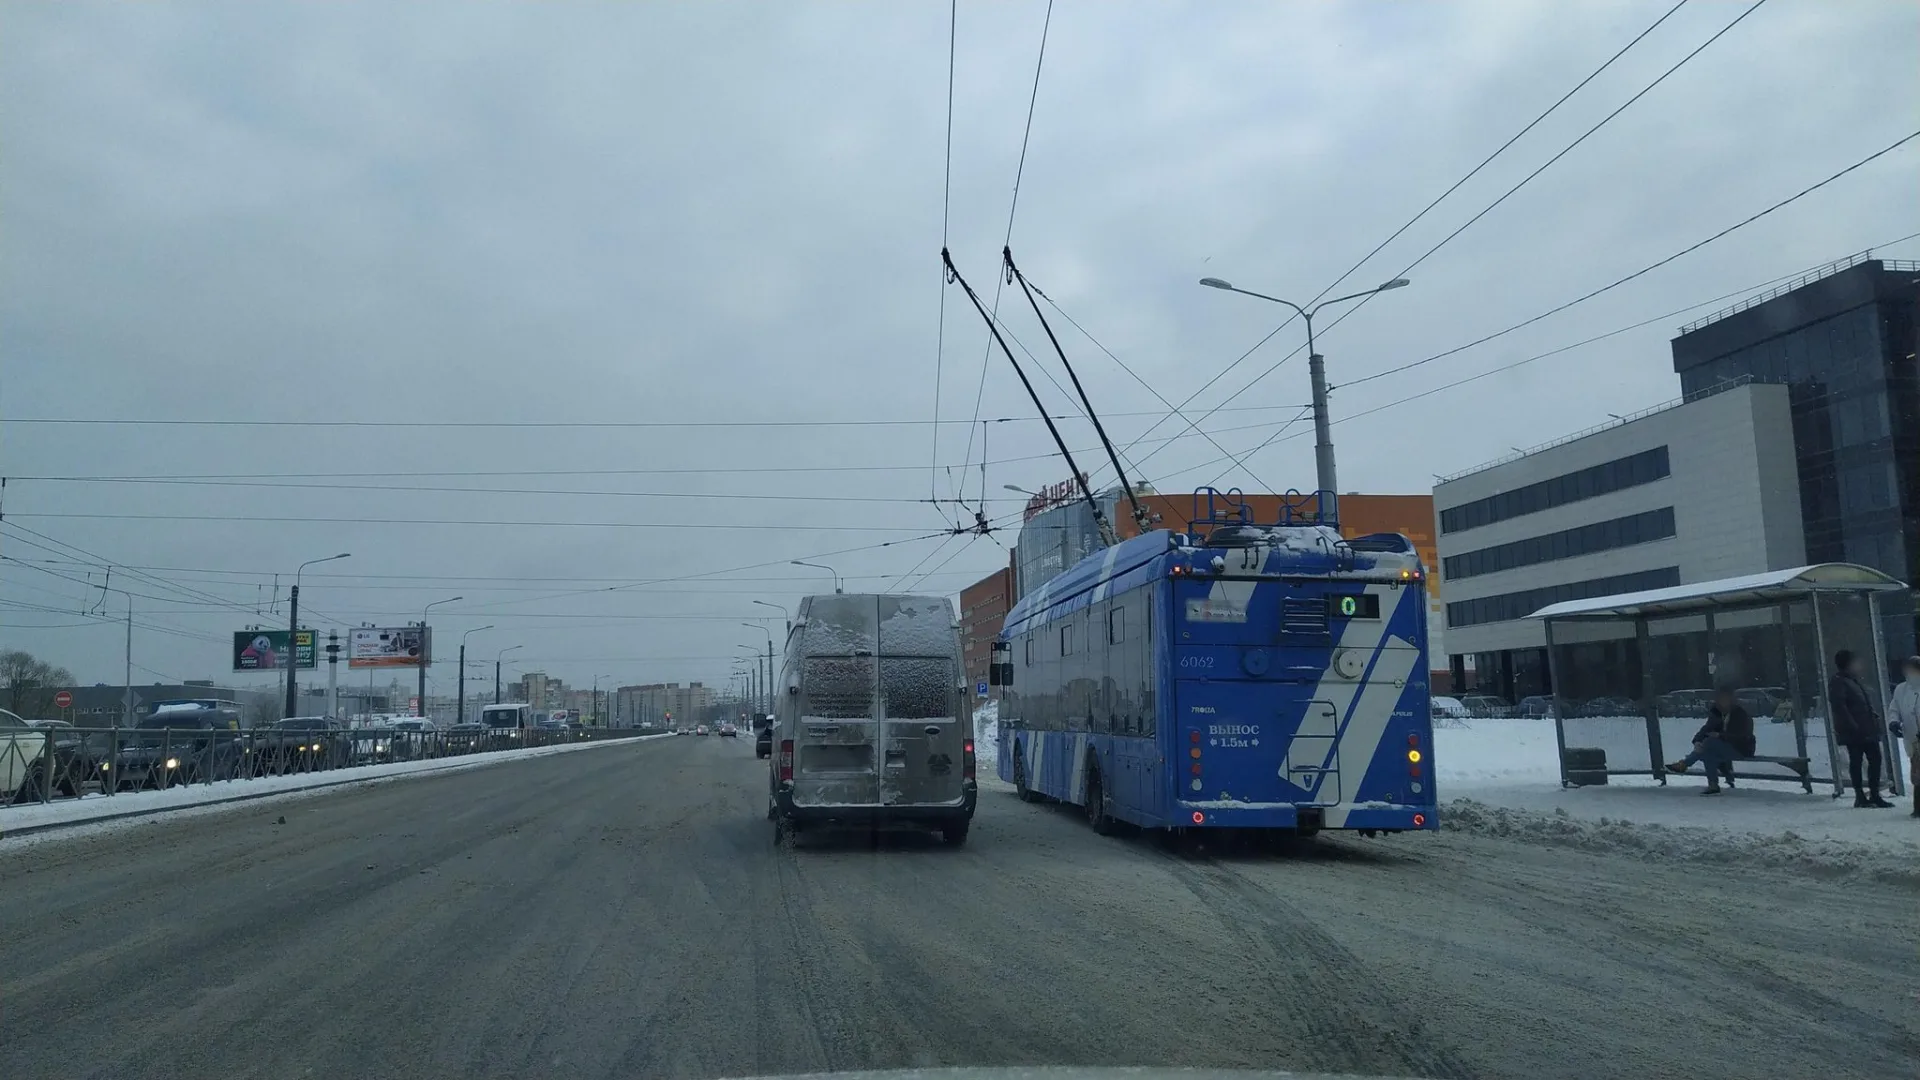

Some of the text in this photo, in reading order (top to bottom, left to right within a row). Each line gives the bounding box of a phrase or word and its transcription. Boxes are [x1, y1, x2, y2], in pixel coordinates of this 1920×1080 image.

[1341, 597, 1355, 615] 0
[1180, 656, 1214, 668] 6062
[1209, 725, 1260, 735] ВЫНОС
